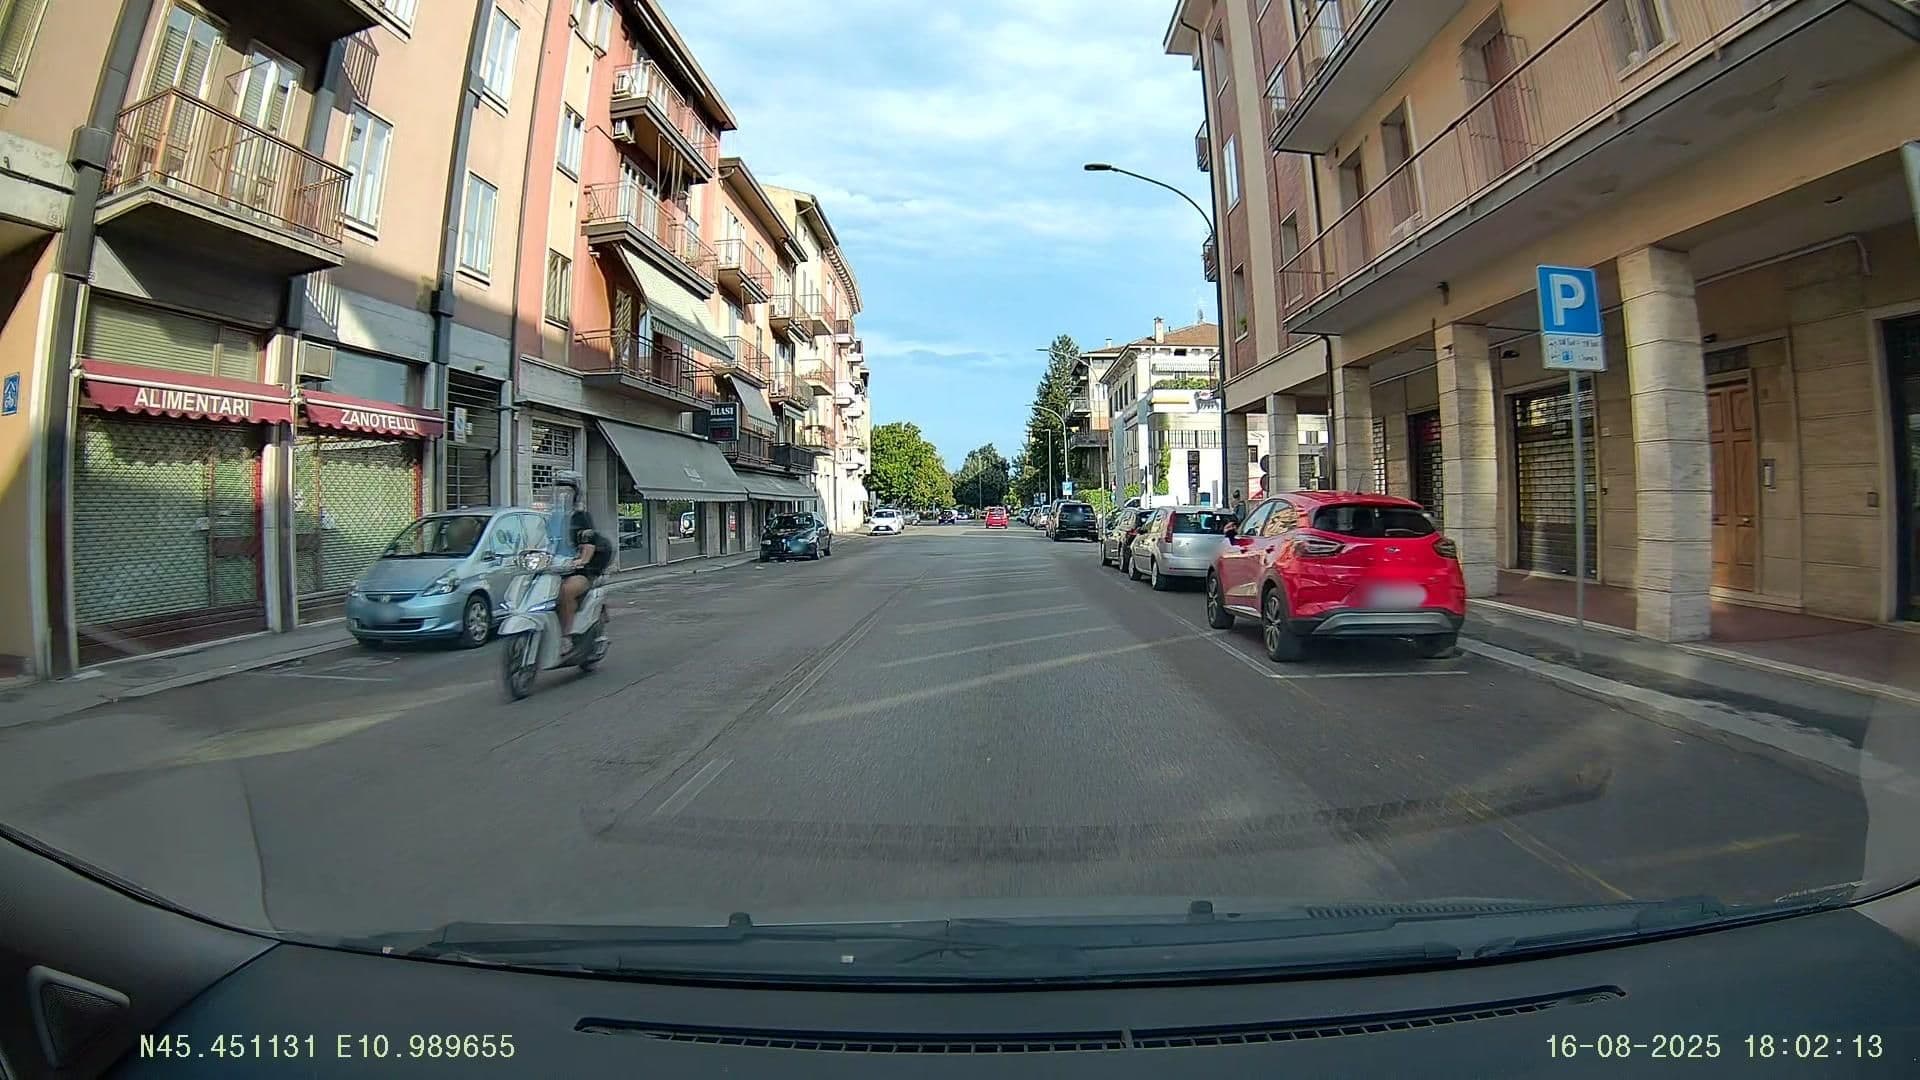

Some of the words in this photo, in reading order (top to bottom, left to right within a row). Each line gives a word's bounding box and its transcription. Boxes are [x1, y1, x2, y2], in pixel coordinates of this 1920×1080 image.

[1549, 273, 1586, 327] P
[134, 387, 251, 417] ALIMENTARI
[340, 408, 417, 431] ZANOTELLI
